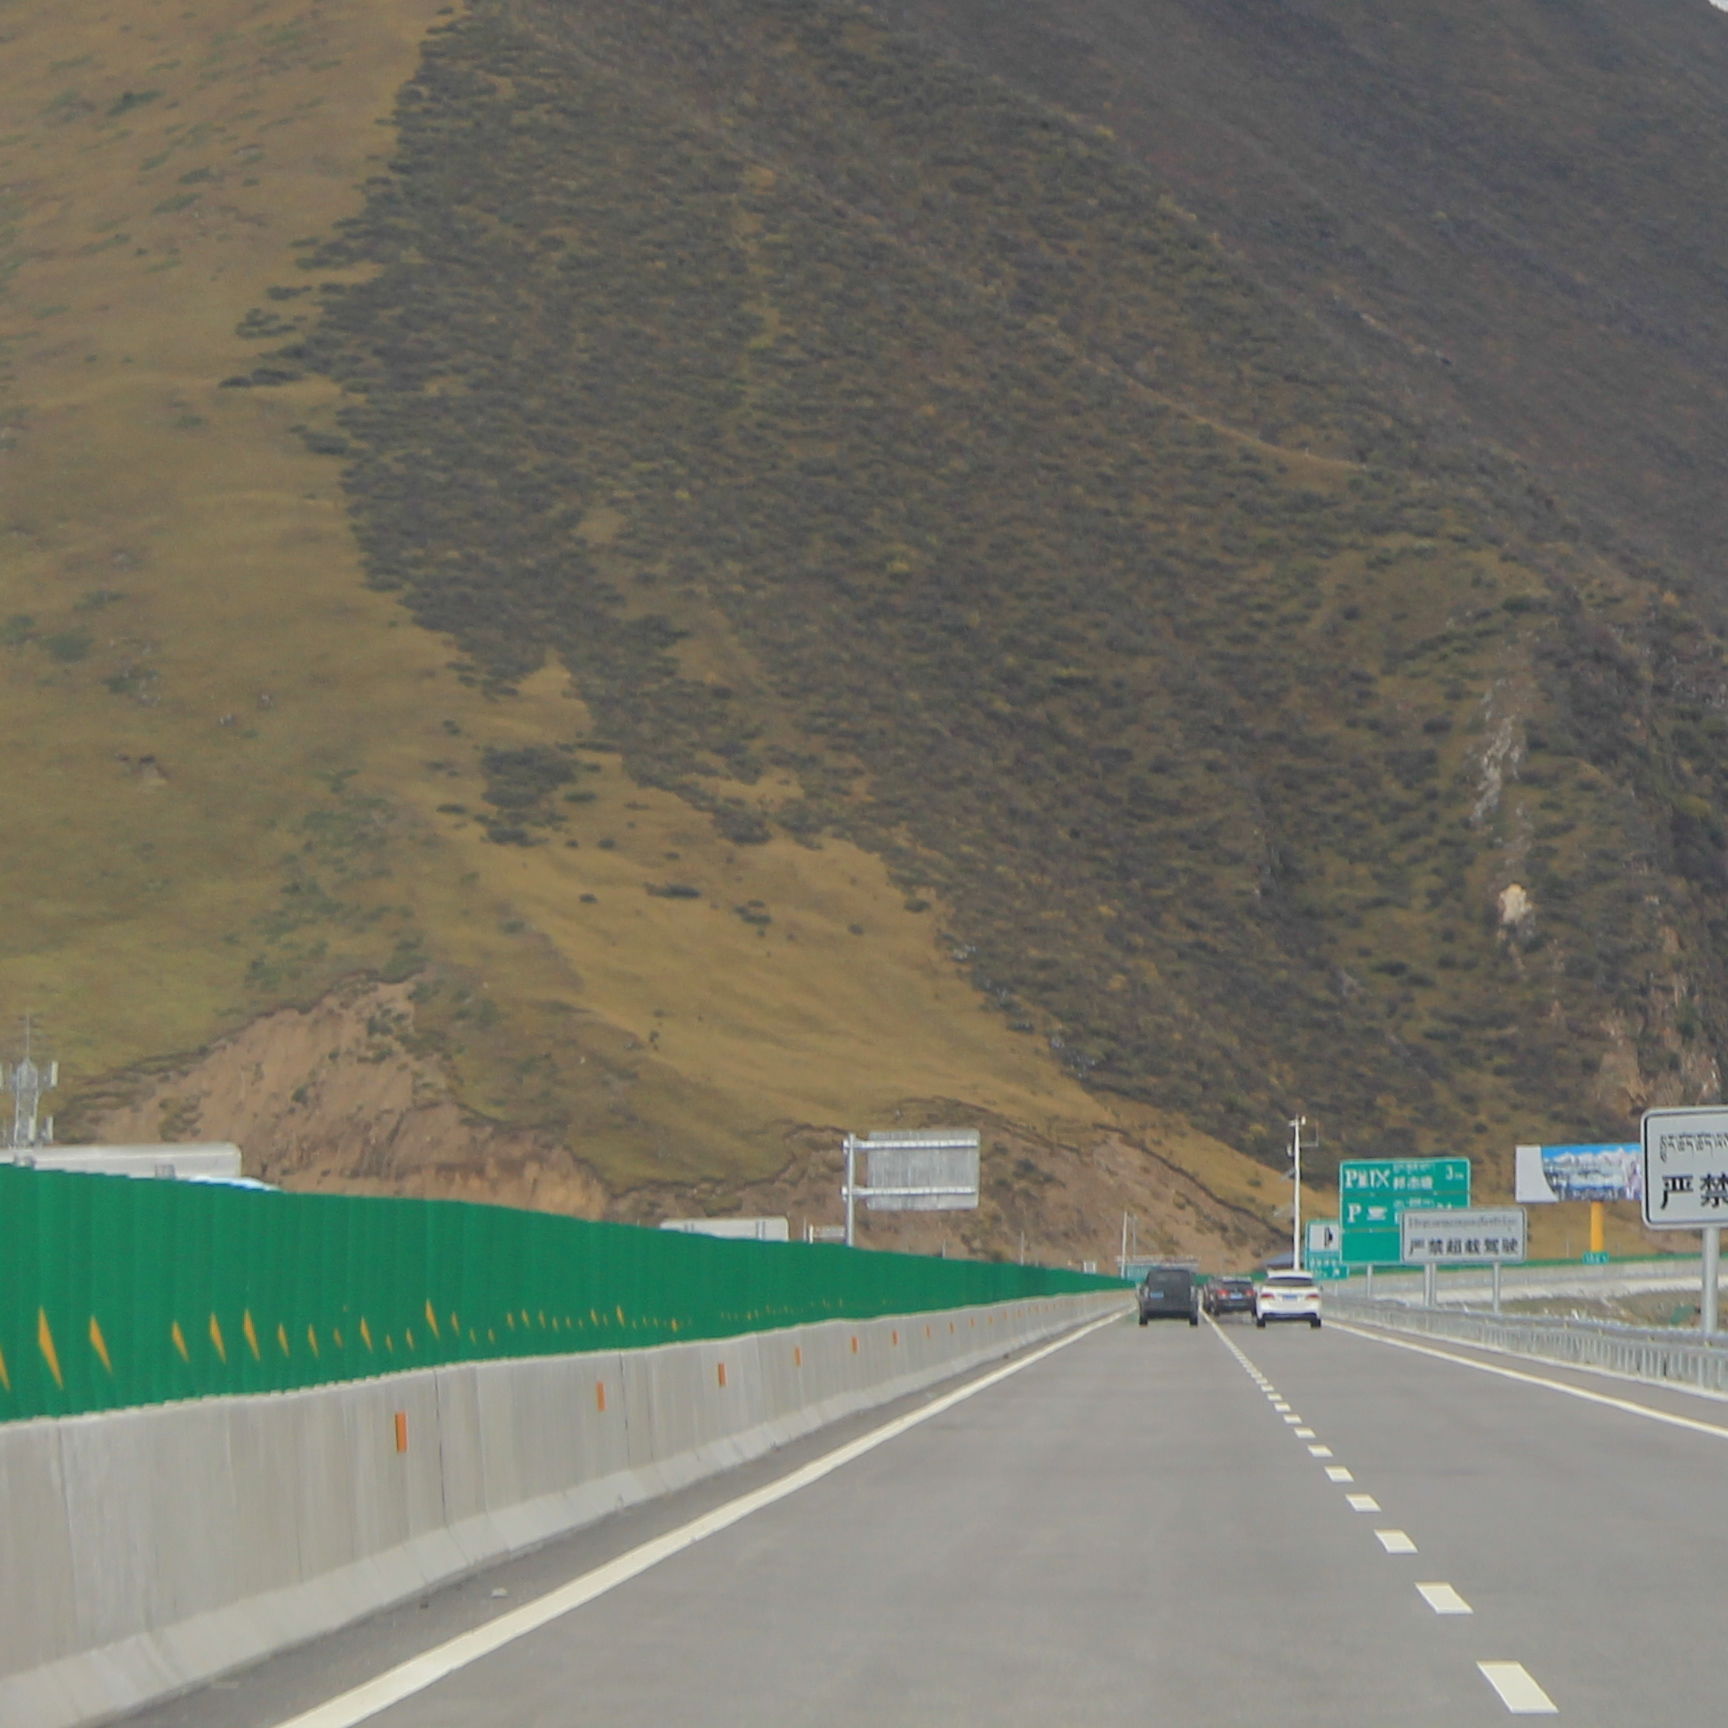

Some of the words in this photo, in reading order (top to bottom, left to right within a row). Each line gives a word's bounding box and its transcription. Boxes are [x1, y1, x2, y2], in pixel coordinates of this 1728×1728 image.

[1345, 1168, 1358, 1188] P
[1347, 1202, 1362, 1223] P
[1409, 1237, 1519, 1256] 严禁超载驾驶
